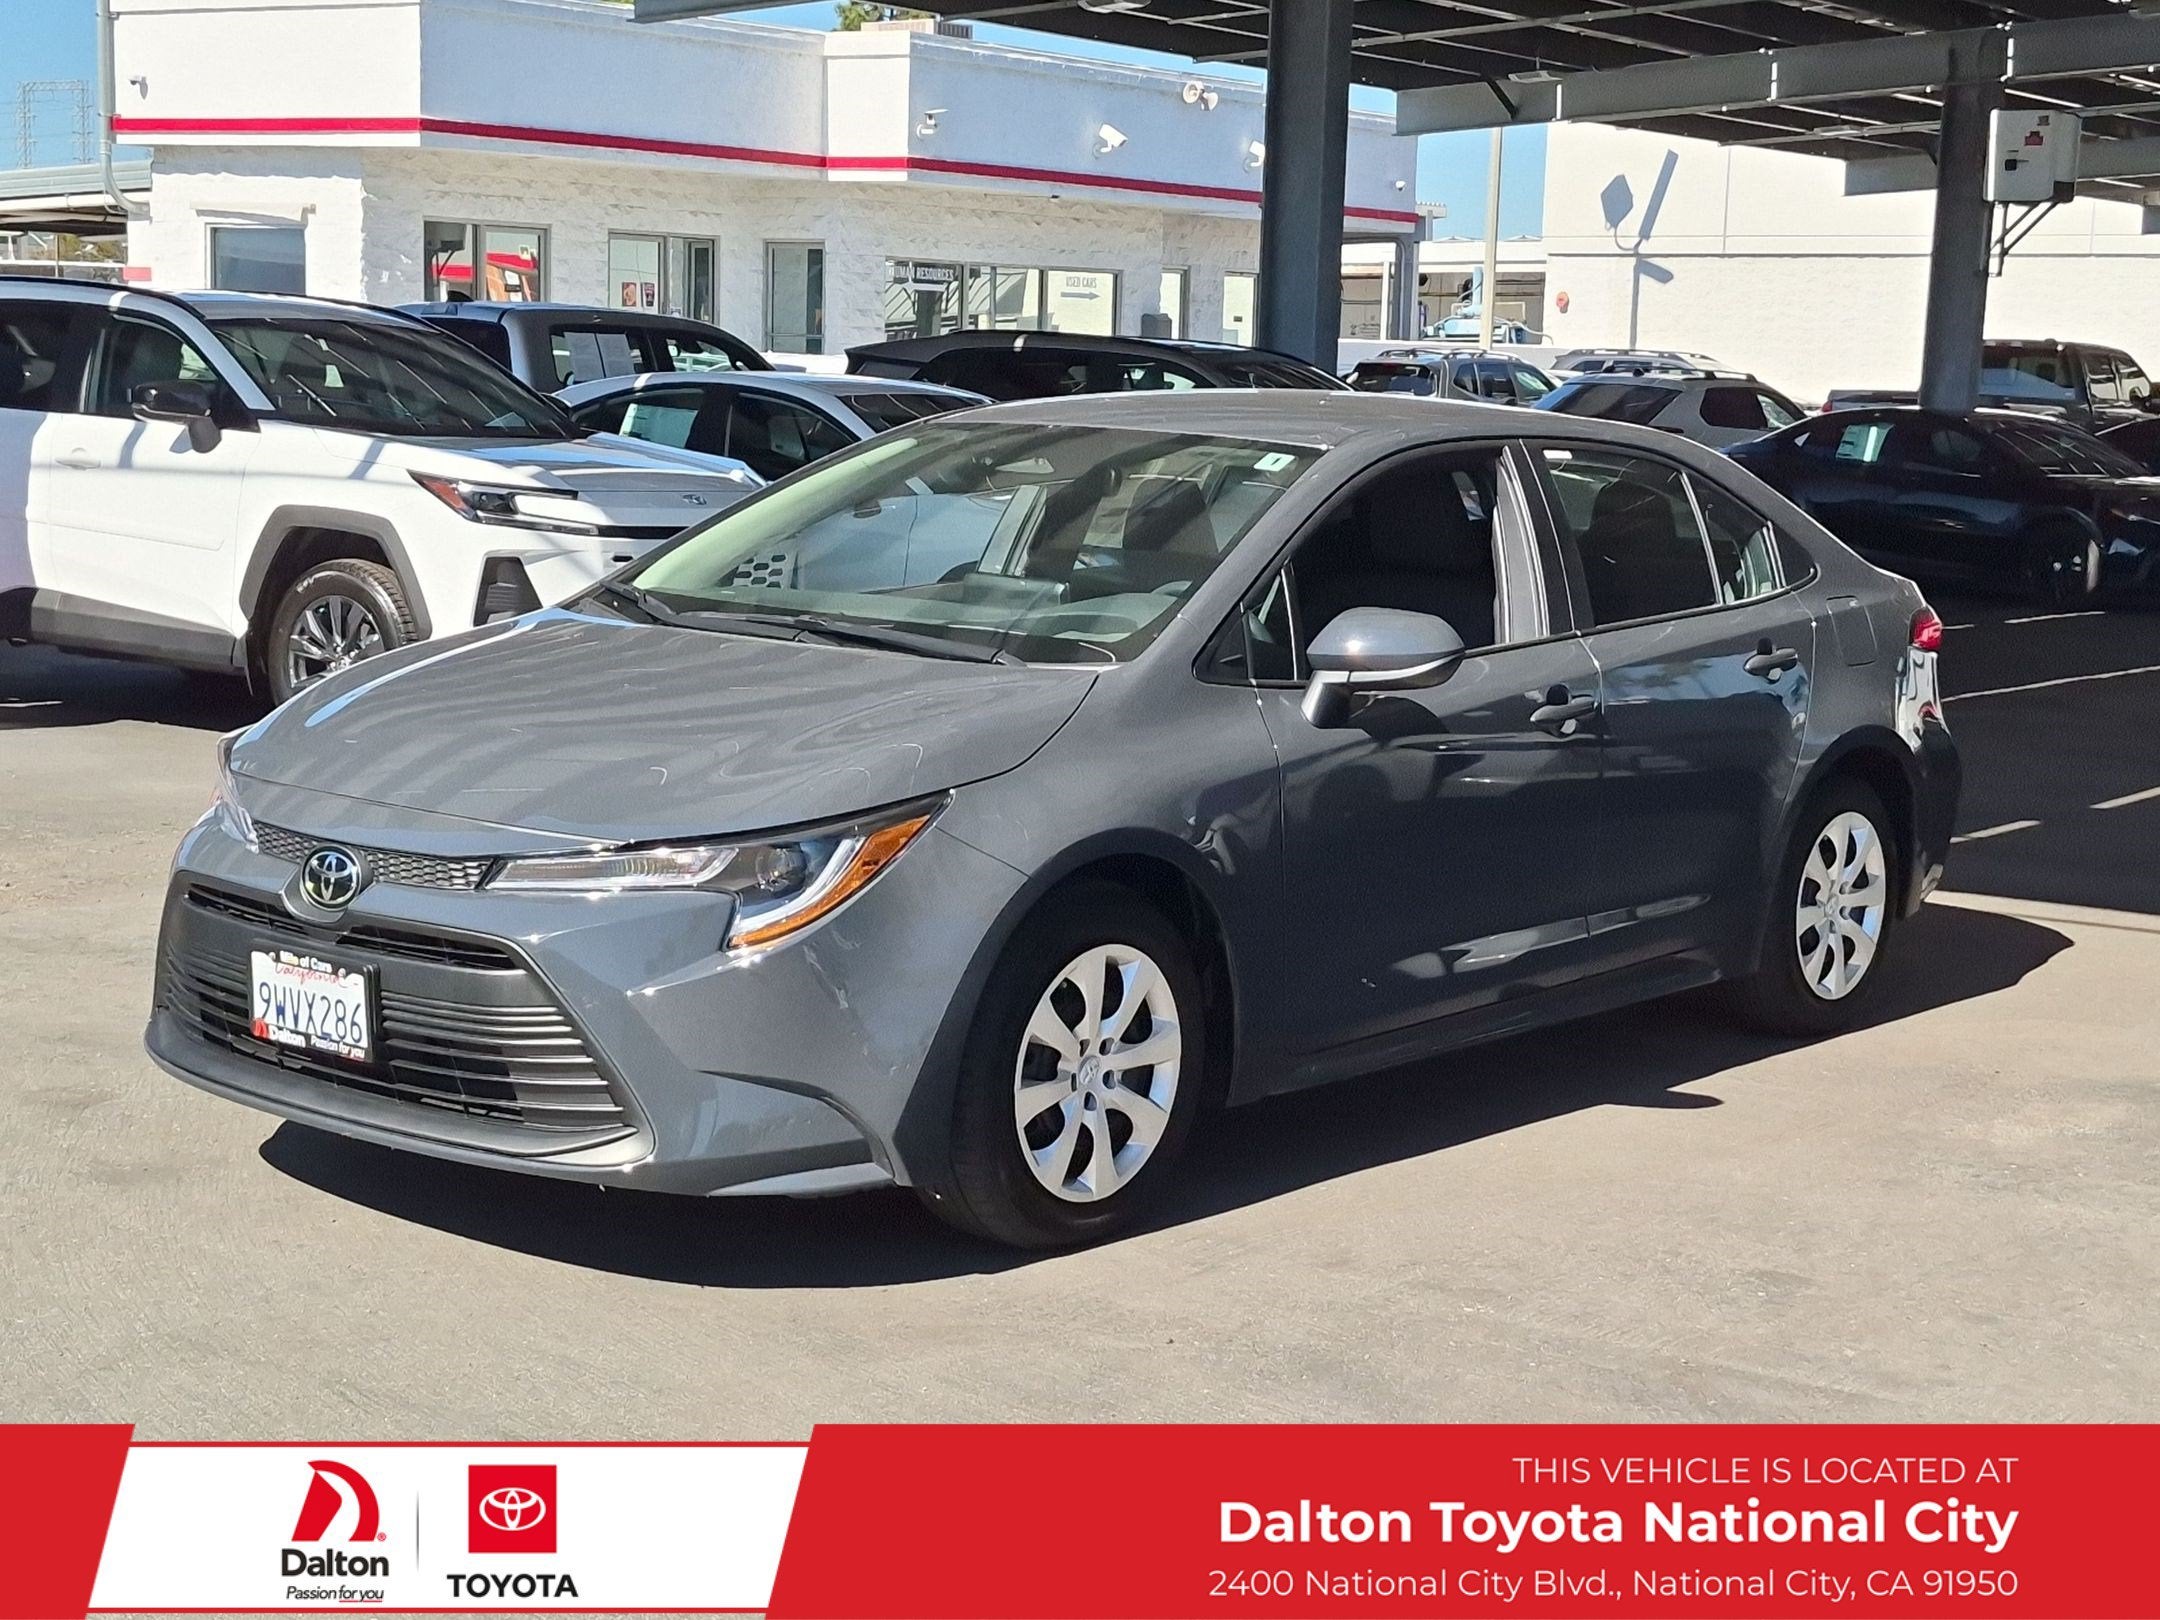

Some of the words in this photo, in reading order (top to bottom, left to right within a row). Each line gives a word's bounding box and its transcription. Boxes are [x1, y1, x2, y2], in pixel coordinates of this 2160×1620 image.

[916, 266, 954, 281] RESOURCES
[1066, 276, 1081, 287] USED
[1082, 277, 1097, 288] CARS
[300, 957, 310, 968] of
[311, 958, 333, 974] Cars
[259, 982, 362, 1043] 9WVX286
[268, 1024, 306, 1048] Dalton
[311, 1035, 338, 1051] Passion
[339, 1041, 351, 1055] for
[350, 1046, 365, 1059] you
